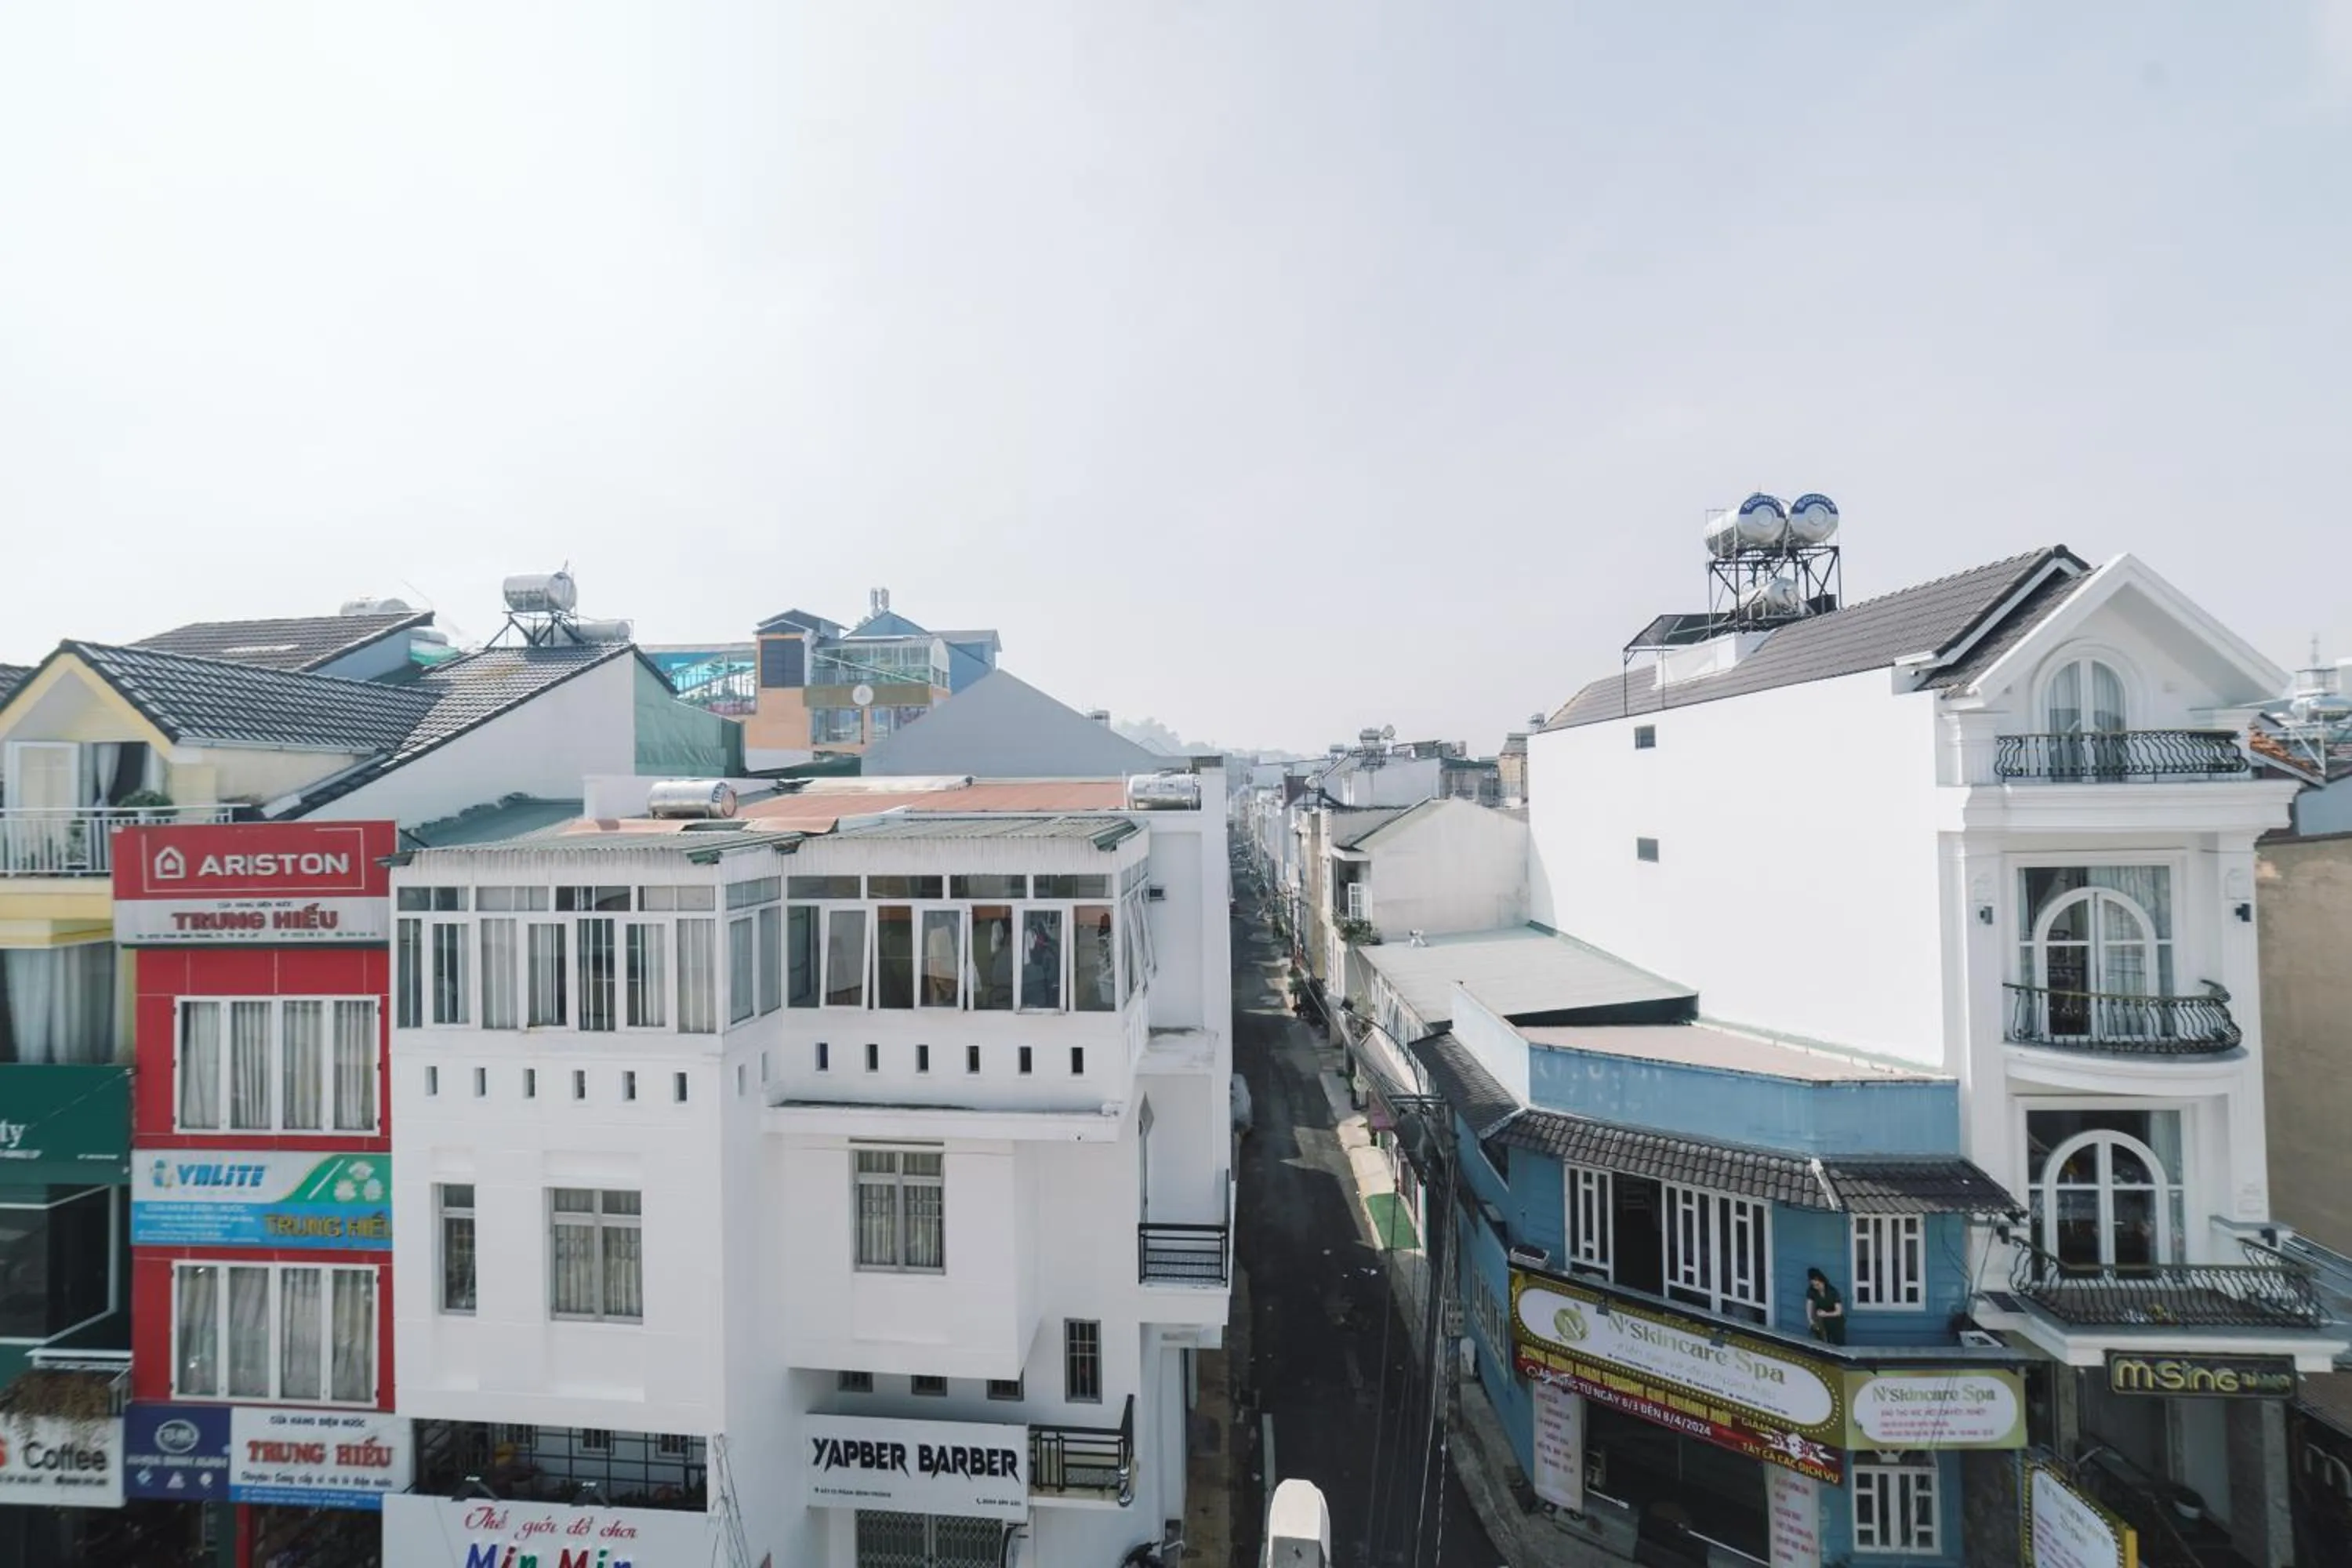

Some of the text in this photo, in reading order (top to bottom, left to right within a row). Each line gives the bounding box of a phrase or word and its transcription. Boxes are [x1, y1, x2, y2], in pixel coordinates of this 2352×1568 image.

[198, 853, 350, 876] ARISTON
[172, 903, 338, 931] TRUNG HIẾU
[265, 1214, 341, 1236] TRUNG
[1736, 1348, 1787, 1385] Spa
[1963, 1384, 1996, 1404] Spa
[24, 1441, 107, 1472] Coffee
[247, 1439, 326, 1465] TRUNG
[336, 1435, 394, 1468] HIẾU
[812, 1438, 1021, 1486] YAPBER BARBER
